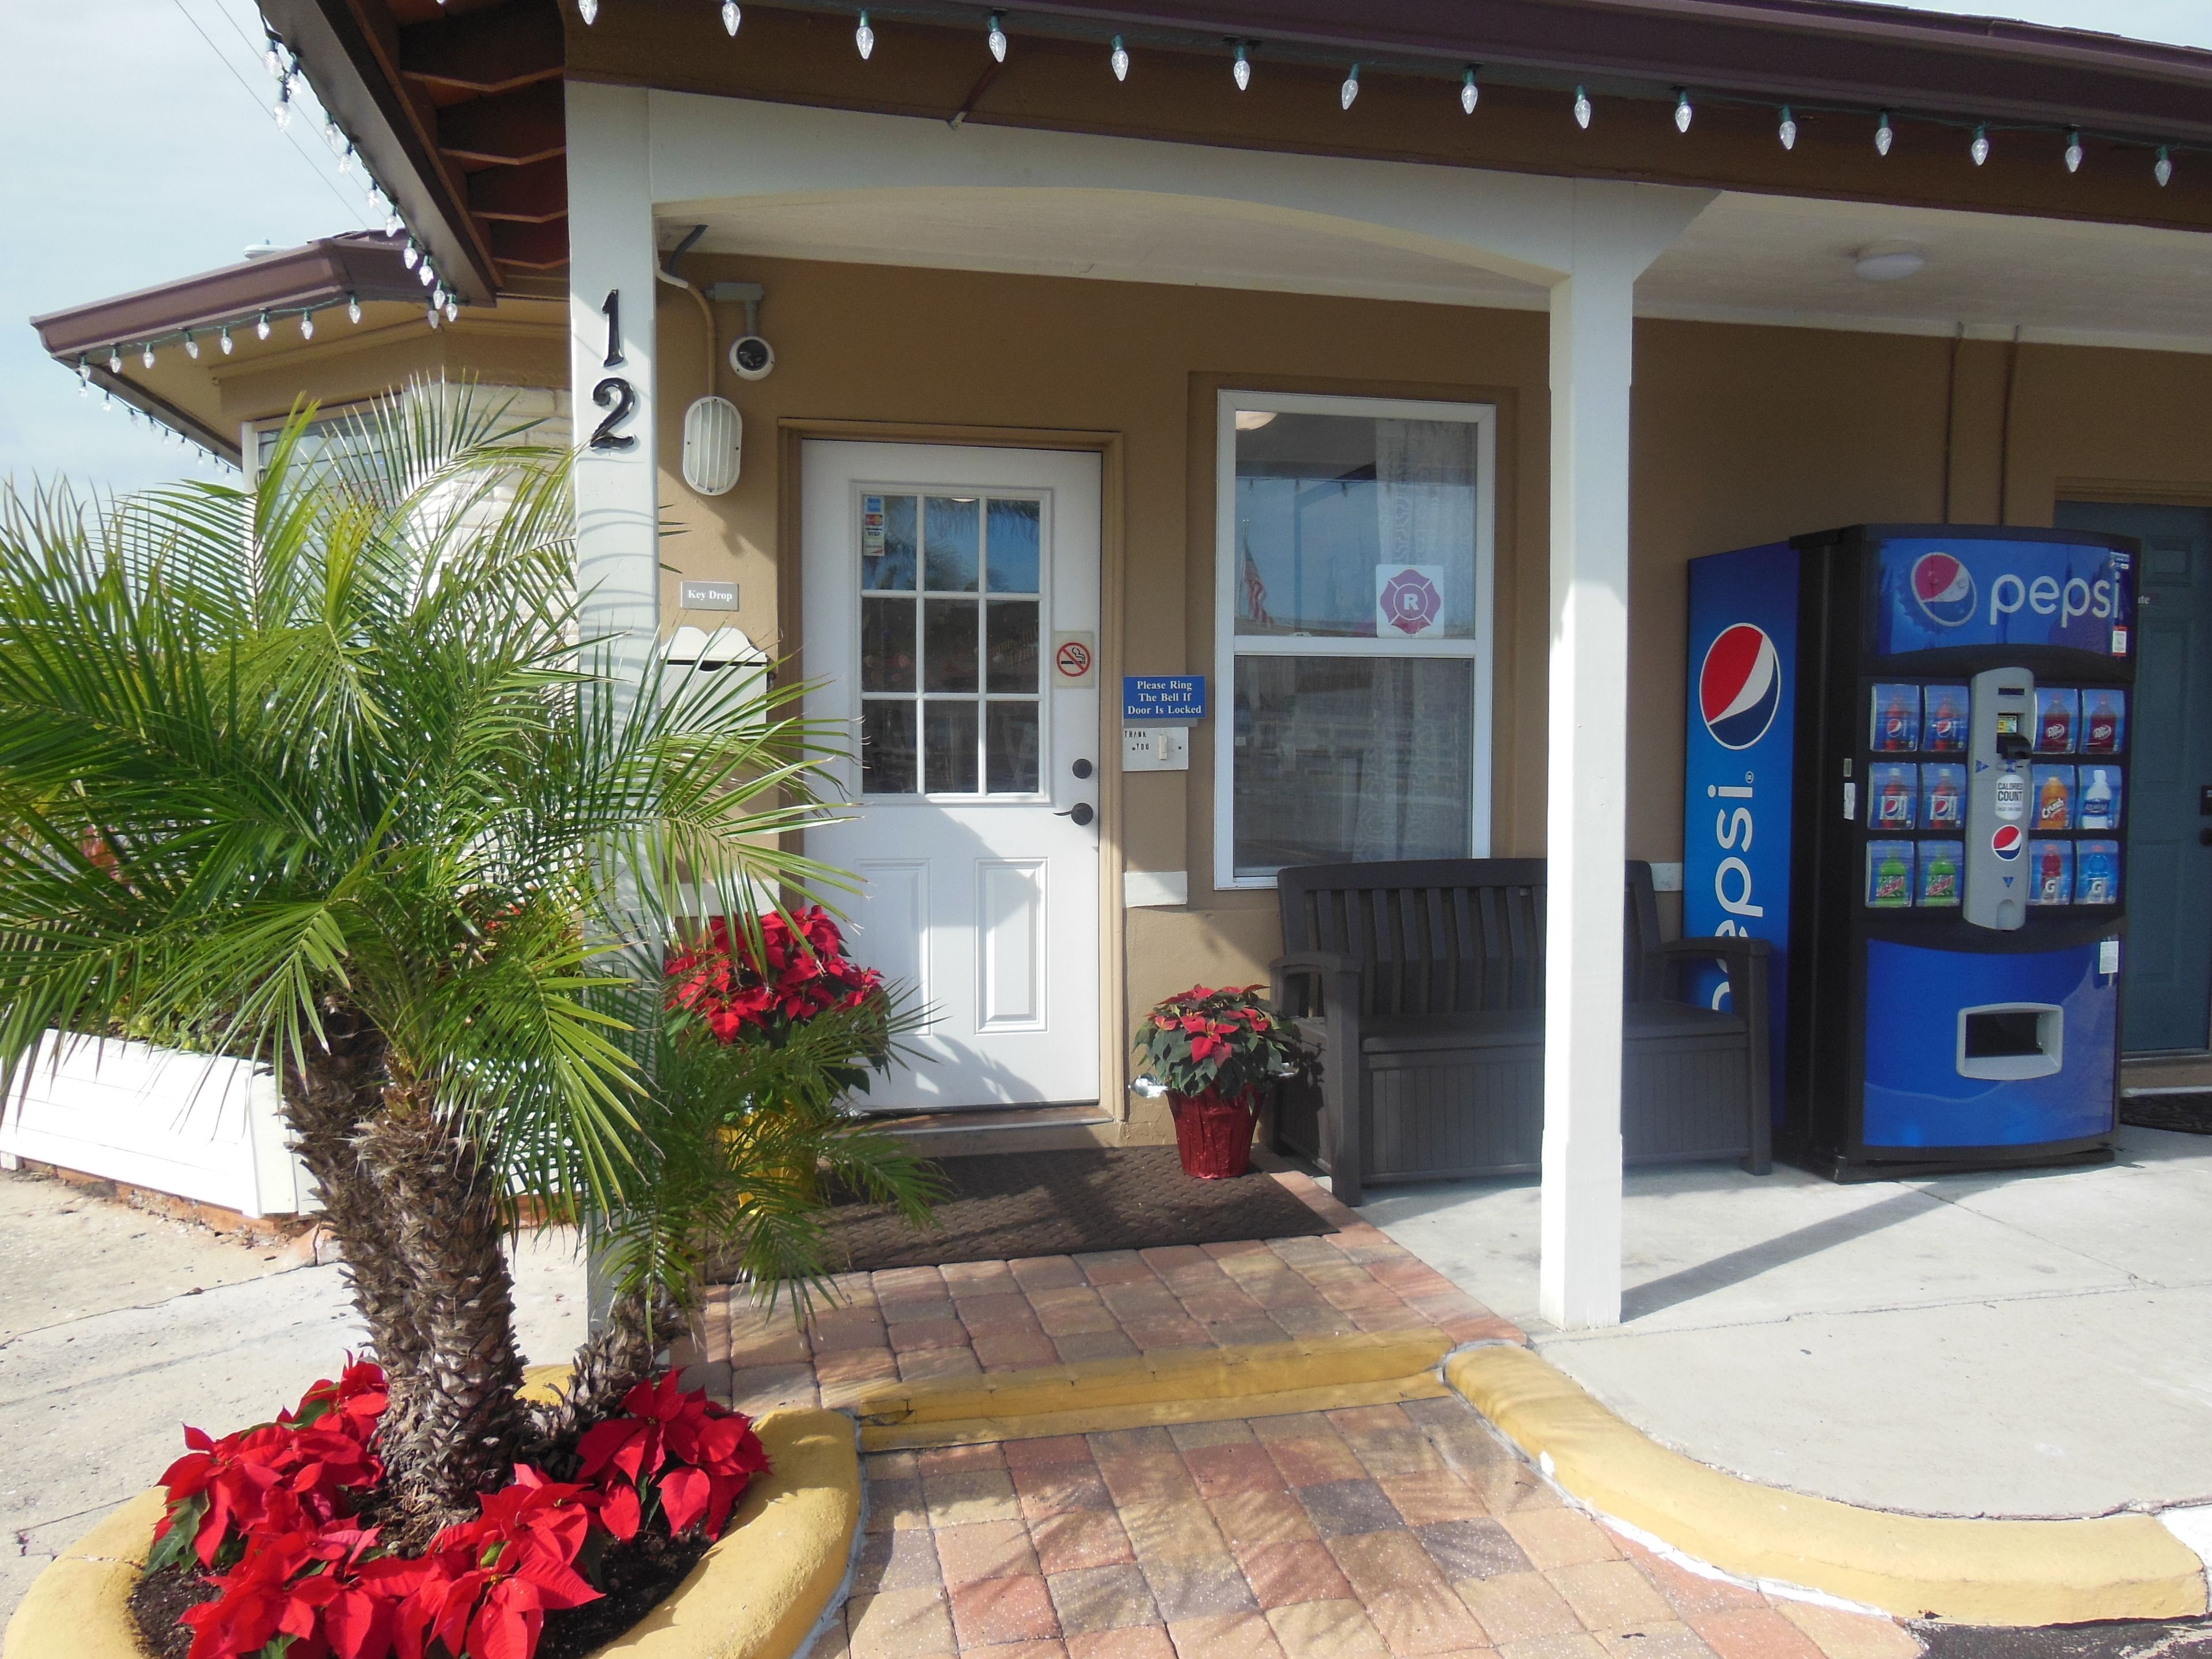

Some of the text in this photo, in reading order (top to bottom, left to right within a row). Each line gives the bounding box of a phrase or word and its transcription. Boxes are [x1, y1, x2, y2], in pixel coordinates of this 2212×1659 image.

[688, 589, 732, 602] Key Drop
[1404, 593, 1419, 610] R
[1990, 574, 2121, 628] pepsi
[1137, 680, 1192, 691] Please Ring
[1138, 692, 1192, 702] The Bell If
[1128, 705, 1202, 714] Door Is Locked
[1998, 791, 2022, 801] COUNT
[2046, 879, 2056, 893] G
[2091, 880, 2102, 893] G
